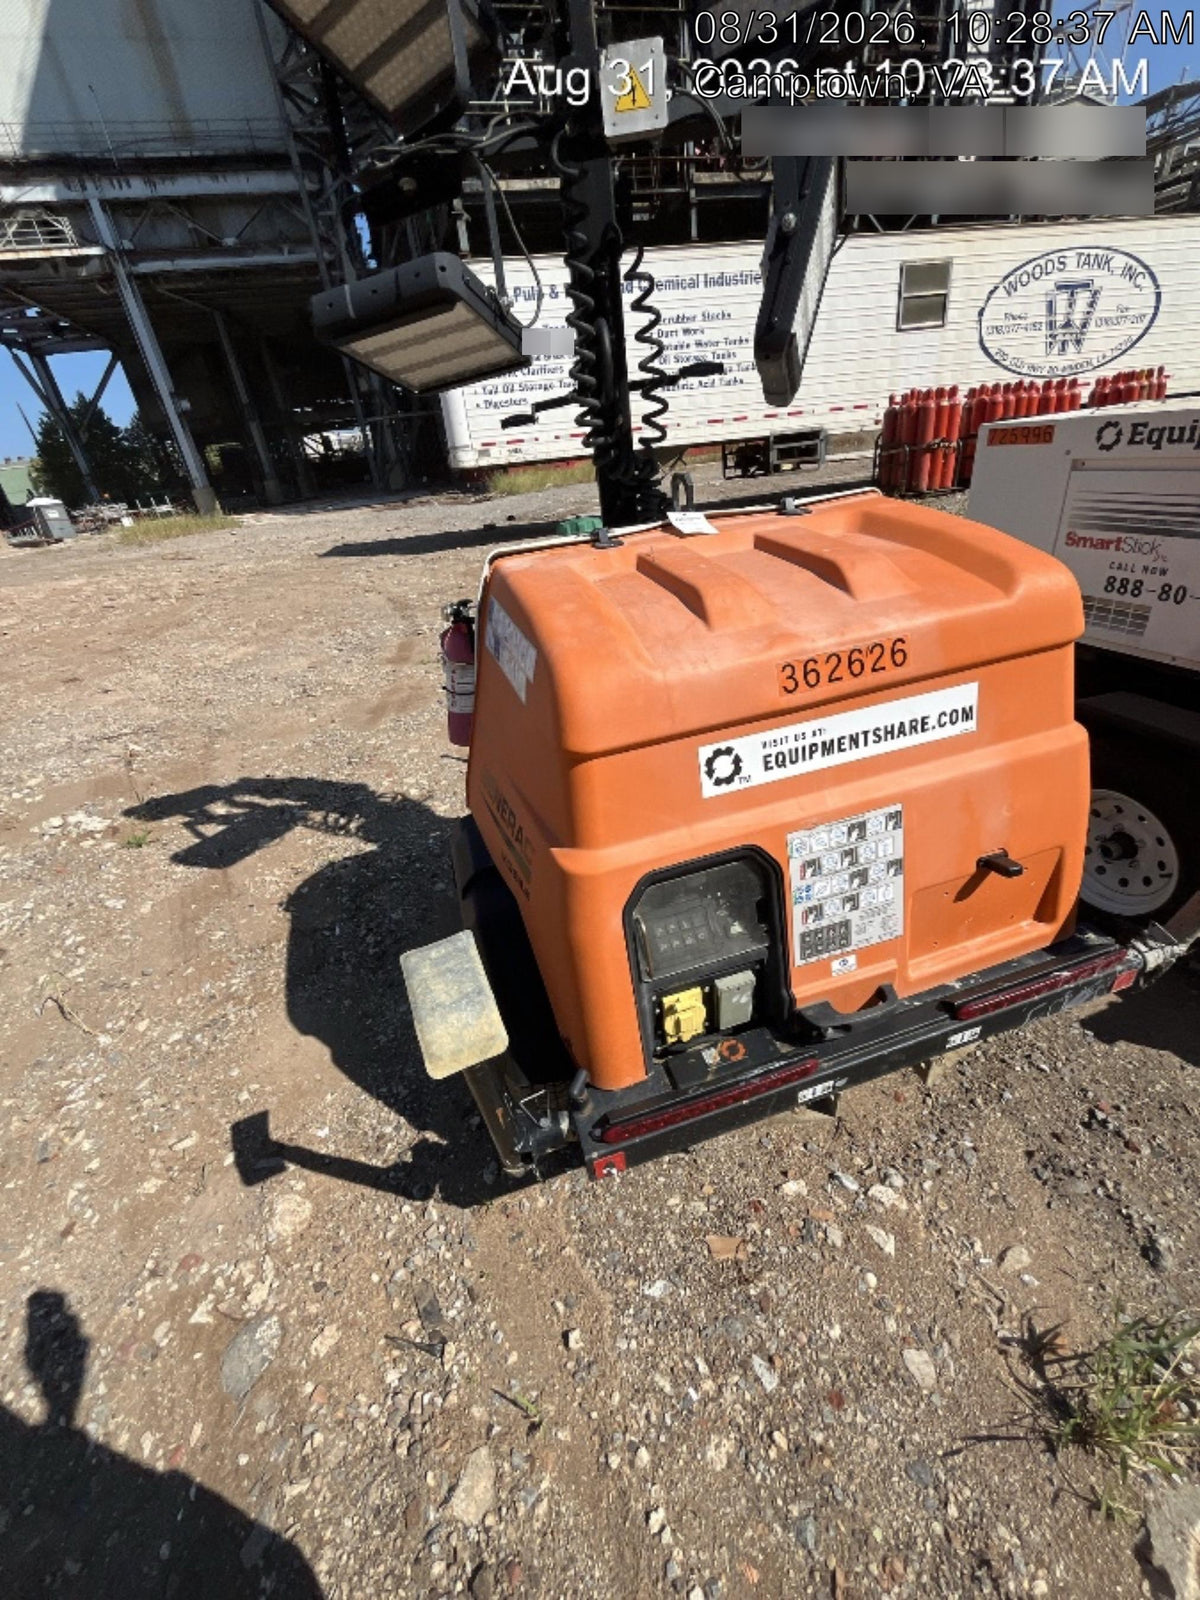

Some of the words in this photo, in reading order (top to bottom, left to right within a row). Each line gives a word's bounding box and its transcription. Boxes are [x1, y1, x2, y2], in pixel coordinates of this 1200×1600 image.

[549, 284, 559, 300] &
[704, 270, 762, 289] Industrie
[1003, 255, 1067, 297] WOODS
[1075, 252, 1114, 275] TANK,
[1109, 561, 1136, 574] CALL
[1142, 565, 1169, 577] NOW
[781, 637, 908, 695] 362626
[760, 734, 789, 750] VISIT
[794, 731, 806, 744] US
[763, 705, 975, 772] EQUIPMENTSHARE.COM
